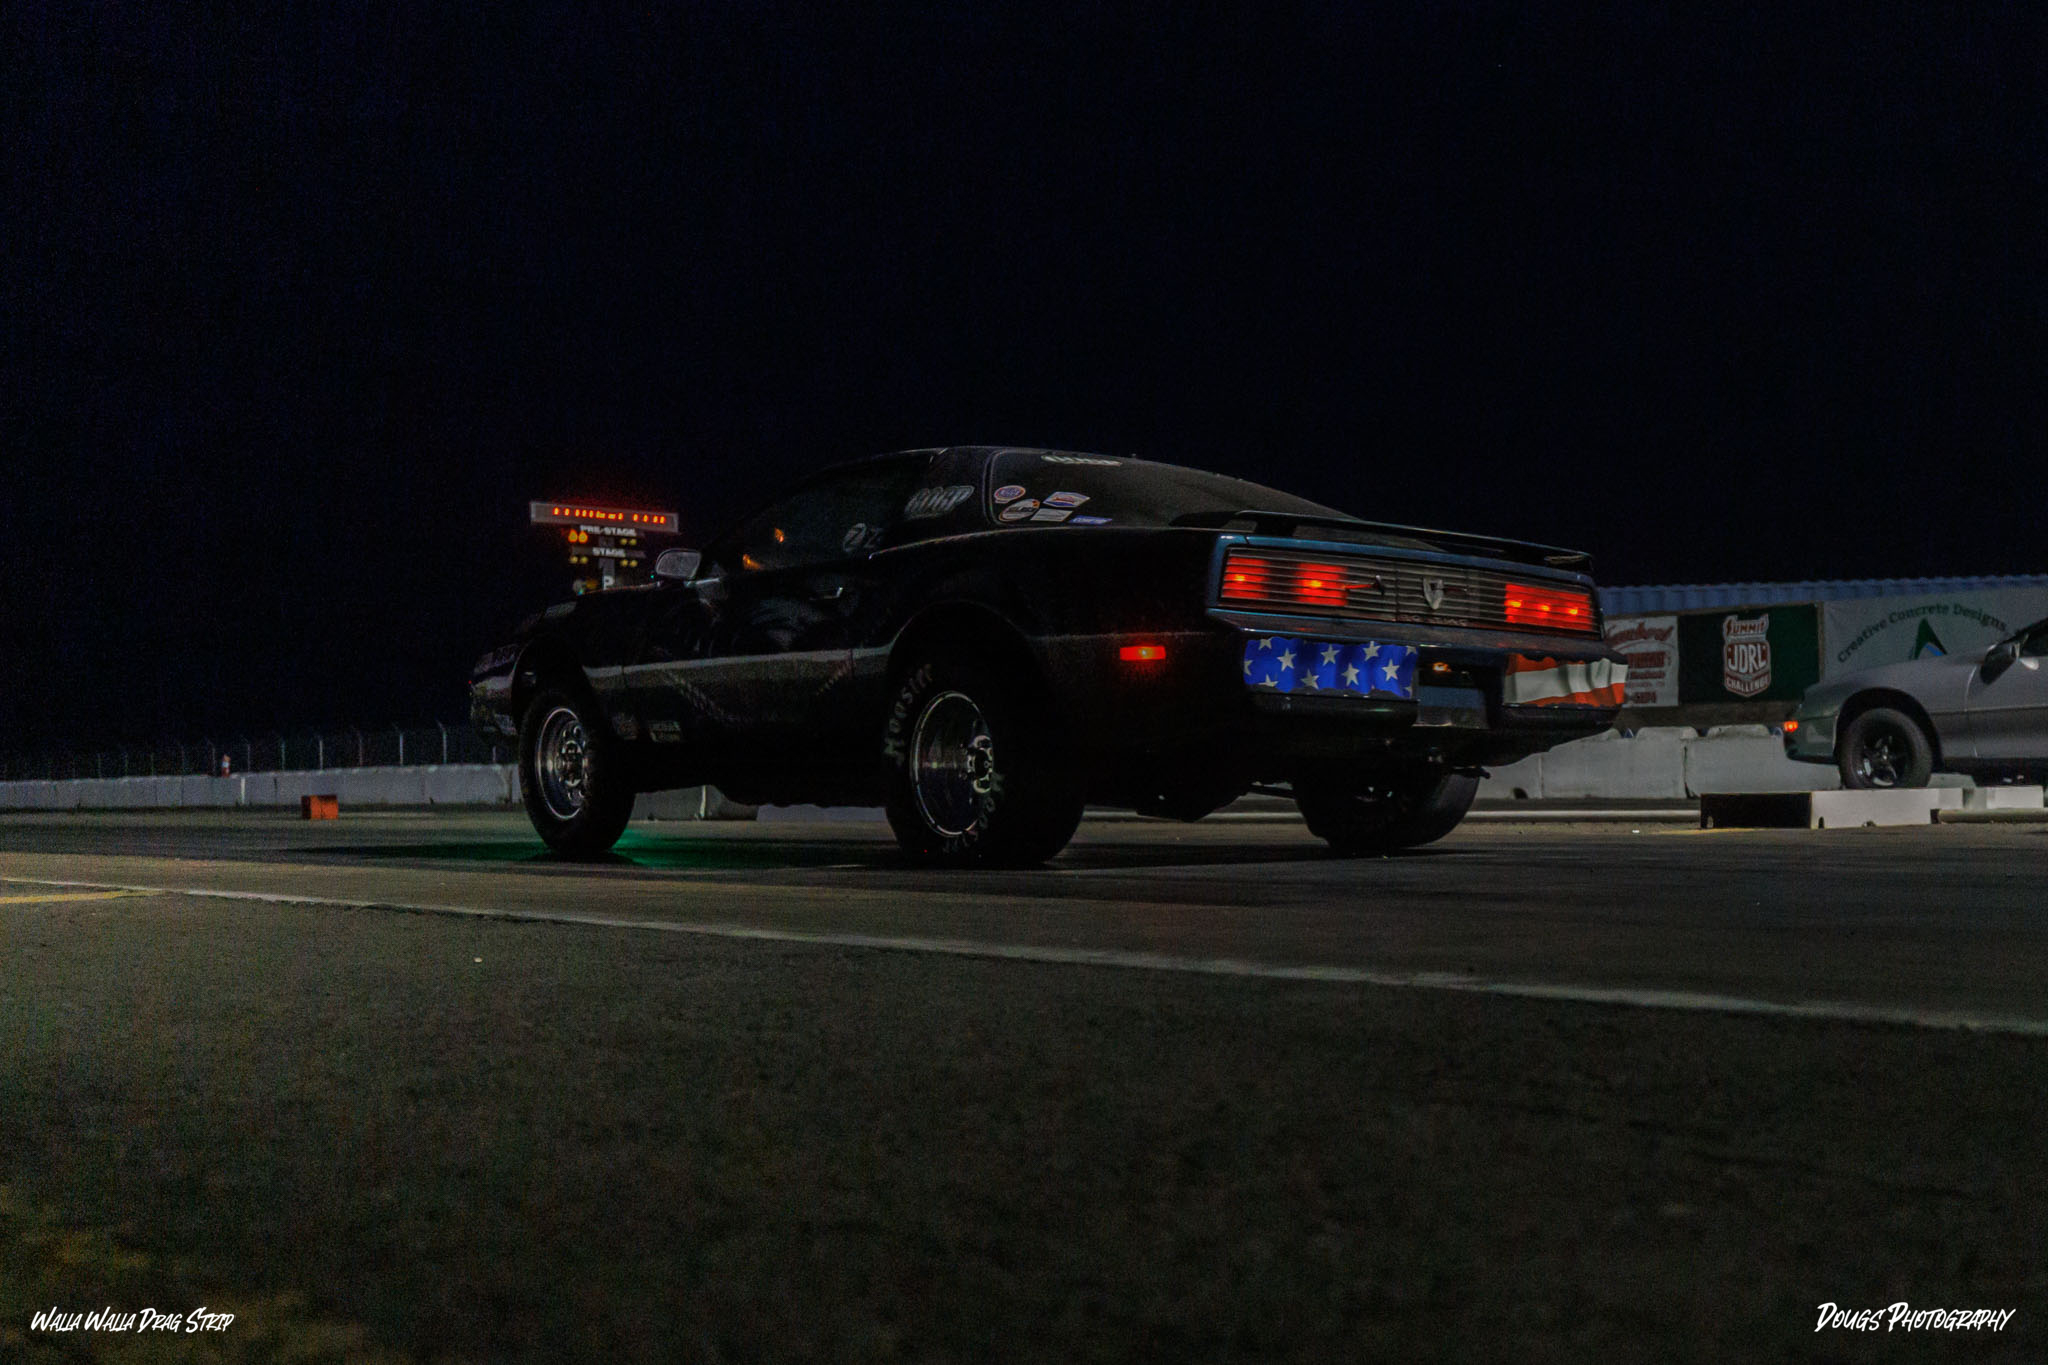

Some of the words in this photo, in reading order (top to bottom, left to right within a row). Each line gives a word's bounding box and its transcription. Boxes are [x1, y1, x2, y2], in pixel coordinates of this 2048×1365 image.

[592, 547, 626, 558] STAGE
[1726, 619, 1766, 636] SUMMIT
[1837, 618, 1888, 662] Creative
[1888, 604, 1949, 624] Concrete
[1952, 603, 2007, 632] Designs
[1727, 643, 1767, 673] JDRL
[1726, 675, 1770, 692] CHALLENGE
